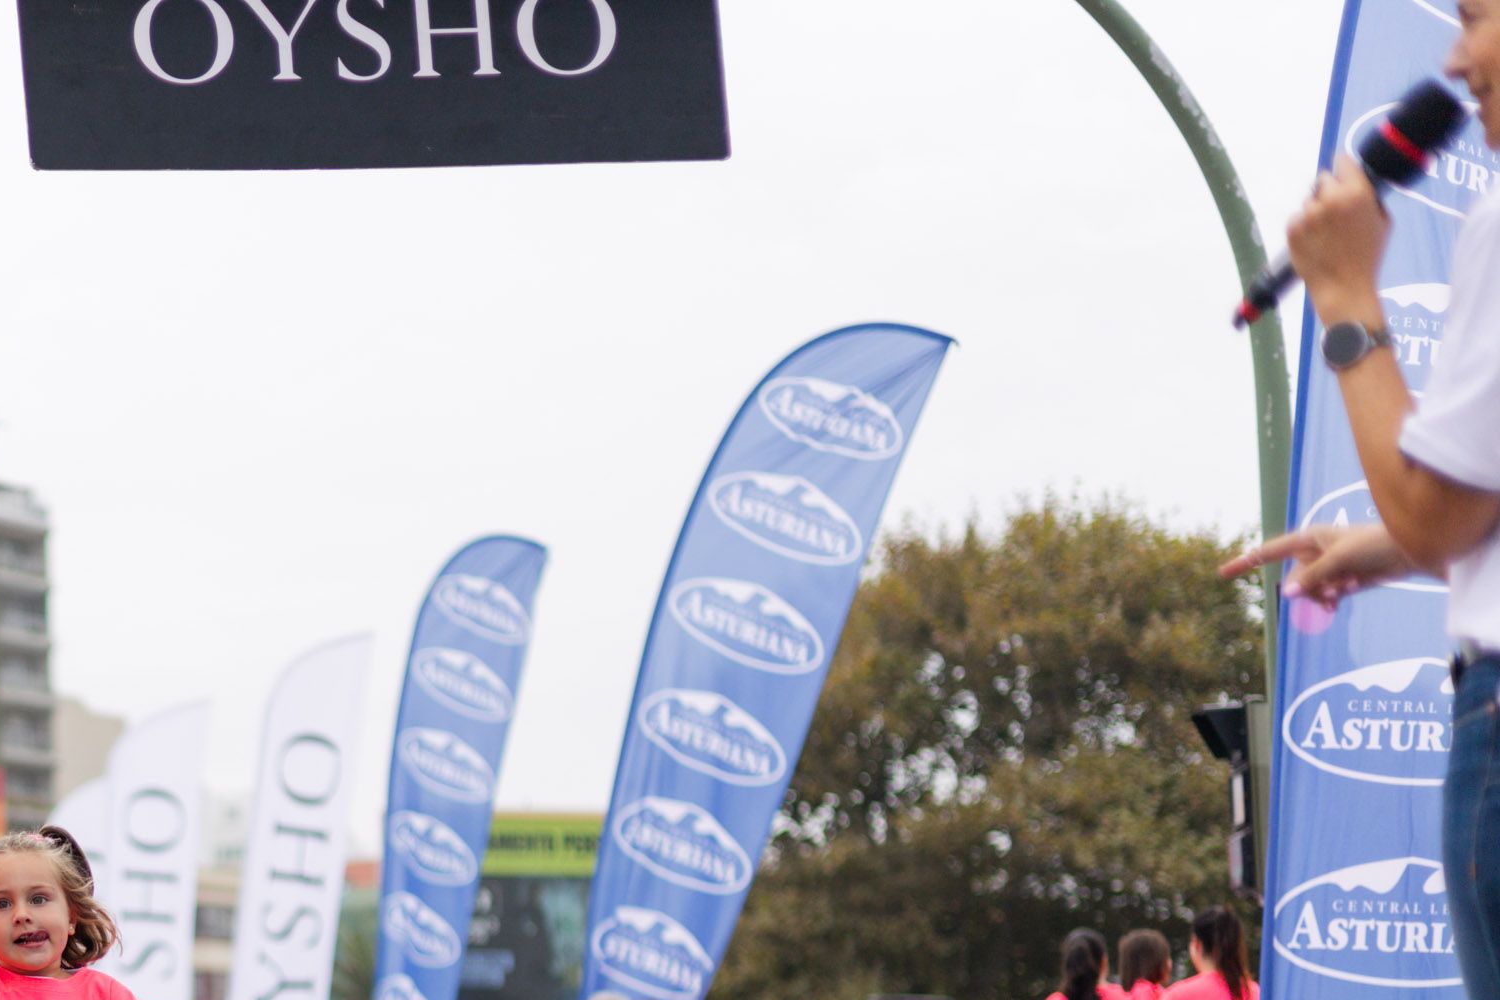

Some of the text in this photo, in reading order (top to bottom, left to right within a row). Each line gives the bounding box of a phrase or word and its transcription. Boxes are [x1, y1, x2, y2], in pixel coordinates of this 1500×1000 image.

[132, 0, 617, 84] OYSHO
[770, 386, 888, 452] ASTURIANA
[719, 484, 848, 557] ASTURIANA
[681, 592, 808, 663] ASTURIANA
[1301, 701, 1452, 752] ASTUR
[1348, 700, 1437, 714] CENTRAL
[649, 702, 771, 778] ASTURIANA
[1288, 901, 1454, 953] ASTURI
[1333, 899, 1421, 914] CENTRAL
[603, 935, 701, 994] STURIANA
